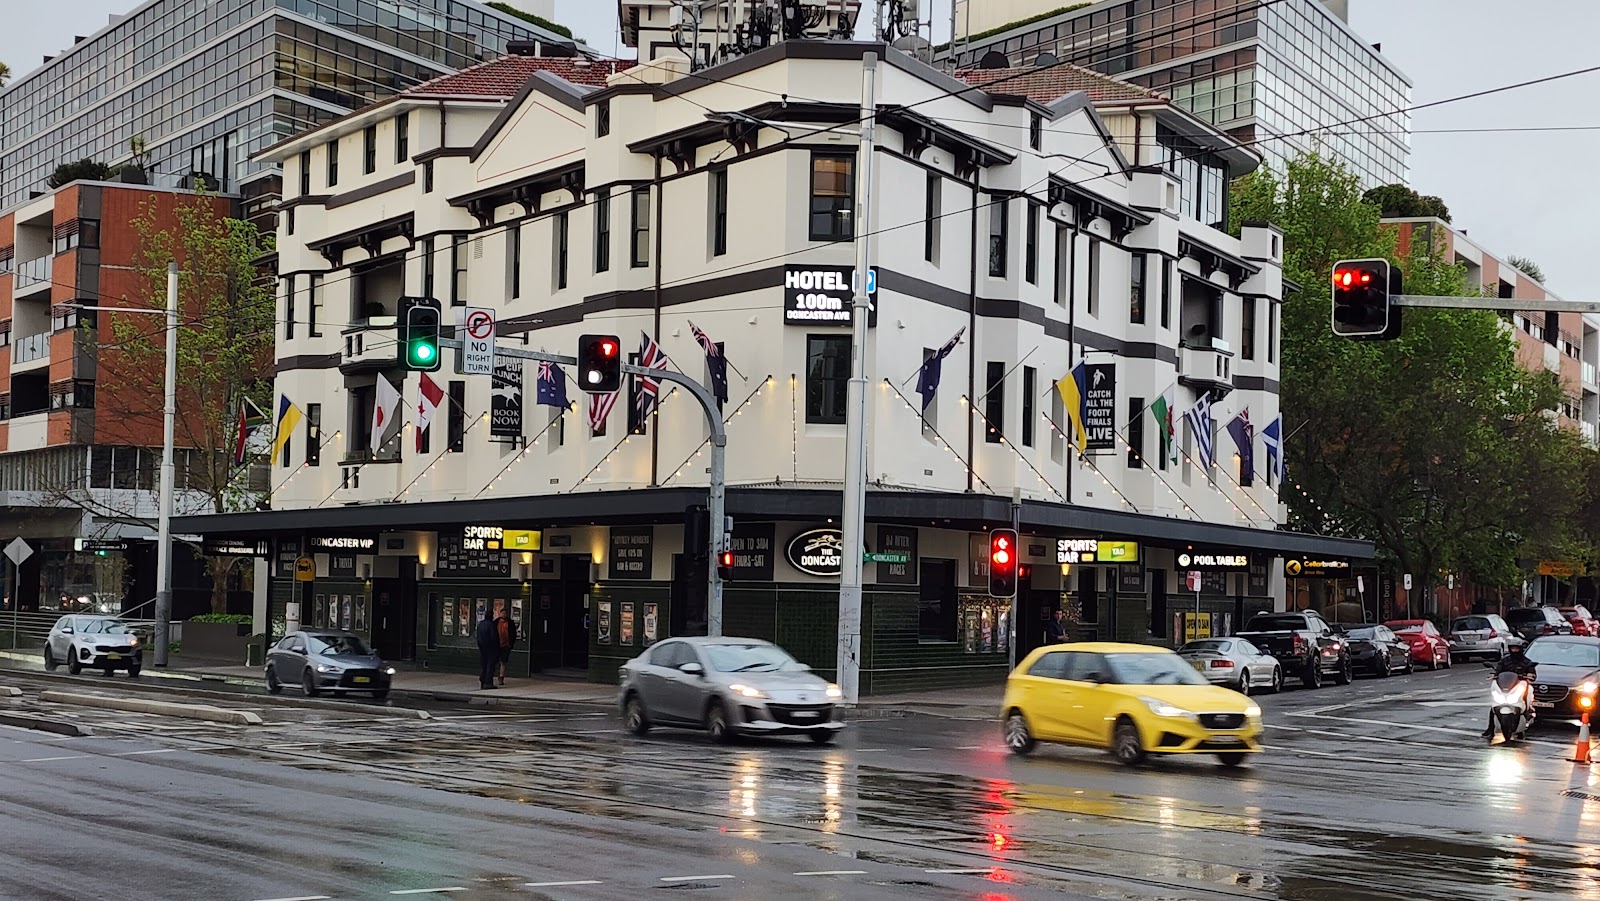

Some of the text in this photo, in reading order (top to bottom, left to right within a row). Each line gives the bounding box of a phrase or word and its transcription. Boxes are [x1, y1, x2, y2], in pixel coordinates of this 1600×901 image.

[785, 271, 849, 290] HOTEL
[796, 293, 842, 310] 100m
[786, 310, 850, 320] DONCASTER AVE
[471, 341, 488, 352] NO
[467, 354, 491, 363] RIGHT
[468, 363, 490, 372] TURN
[506, 363, 522, 372] CUP
[1088, 390, 1111, 399] CATCH
[1086, 399, 1113, 407] ALL THE
[493, 409, 520, 417] BOOK
[1088, 409, 1111, 417] FOOTY
[492, 417, 520, 425] NOW
[1087, 418, 1112, 426] FINALS
[1086, 427, 1113, 440] LIVE
[464, 526, 503, 539] SPORTS
[311, 537, 374, 548] DONCASTER VIP
[463, 538, 484, 550] BAR
[730, 538, 769, 550] OPEN TO 3AM
[1057, 539, 1098, 552] SPORTS
[801, 555, 840, 566] DONCAST
[875, 554, 900, 562] DONCASTER
[1057, 551, 1079, 563] BAR
[1193, 555, 1248, 566] POOL TABLES
